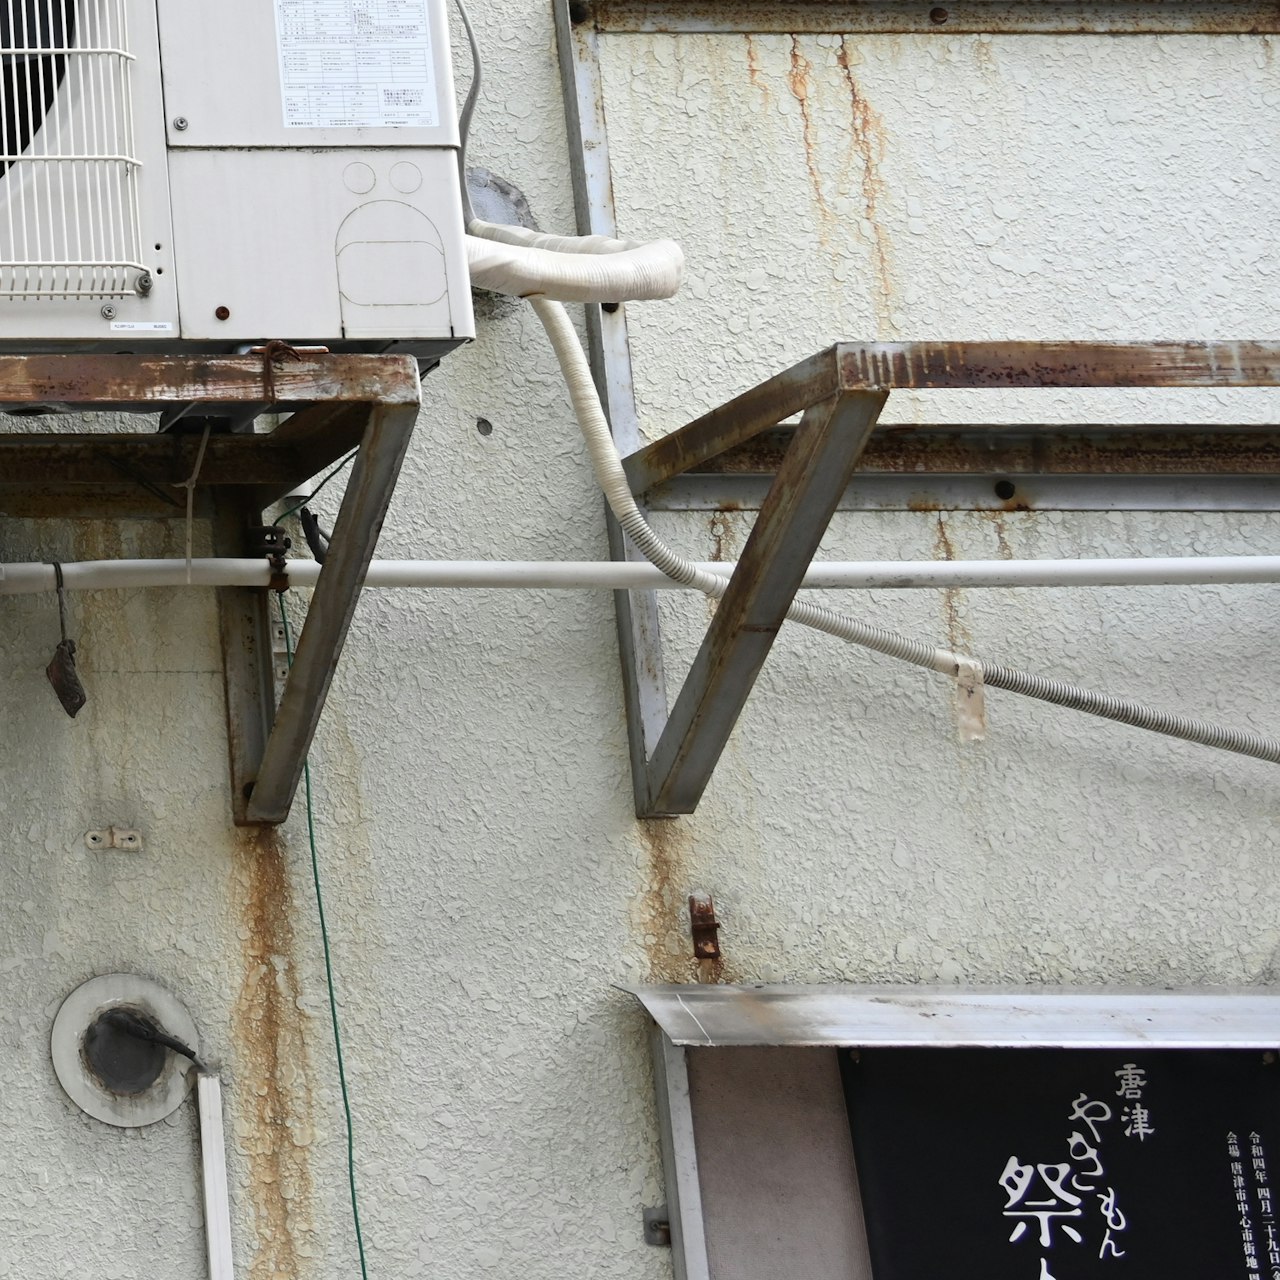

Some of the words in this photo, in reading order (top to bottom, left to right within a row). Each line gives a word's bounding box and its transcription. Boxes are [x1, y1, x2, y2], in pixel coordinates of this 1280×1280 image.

[1114, 1063, 1155, 1141] 唐津
[1227, 1131, 1240, 1158] 会場
[1249, 1131, 1267, 1183] 令和四年
[998, 1155, 1082, 1280] 祭
[1231, 1161, 1258, 1269] 唐津市中心市街地
